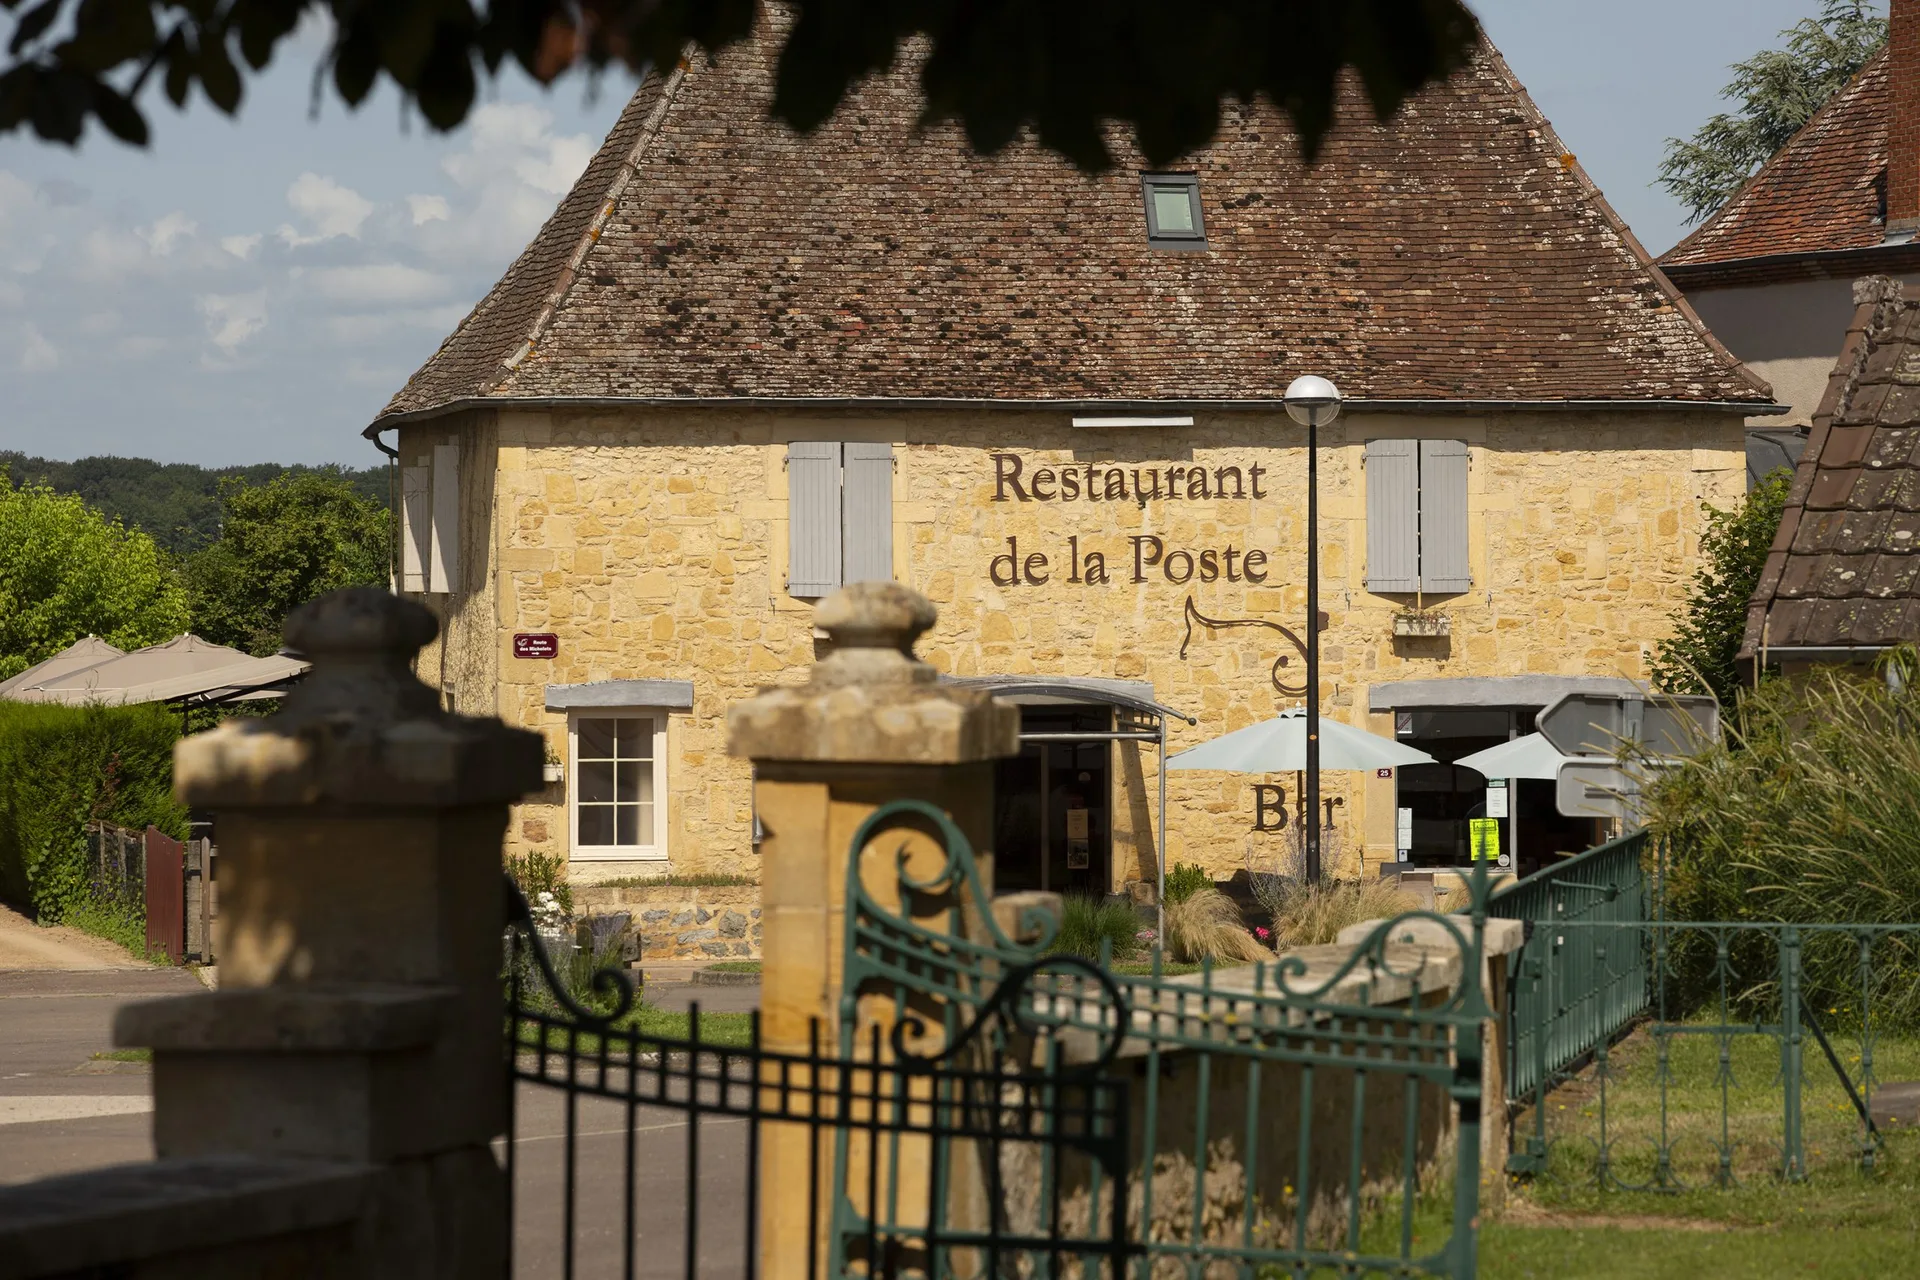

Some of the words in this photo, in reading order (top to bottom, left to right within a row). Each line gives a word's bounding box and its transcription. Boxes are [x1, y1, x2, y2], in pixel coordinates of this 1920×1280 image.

[989, 453, 1267, 502] Restaurant
[989, 535, 1050, 587] de
[1066, 535, 1110, 585] la
[1127, 534, 1268, 585] Poste
